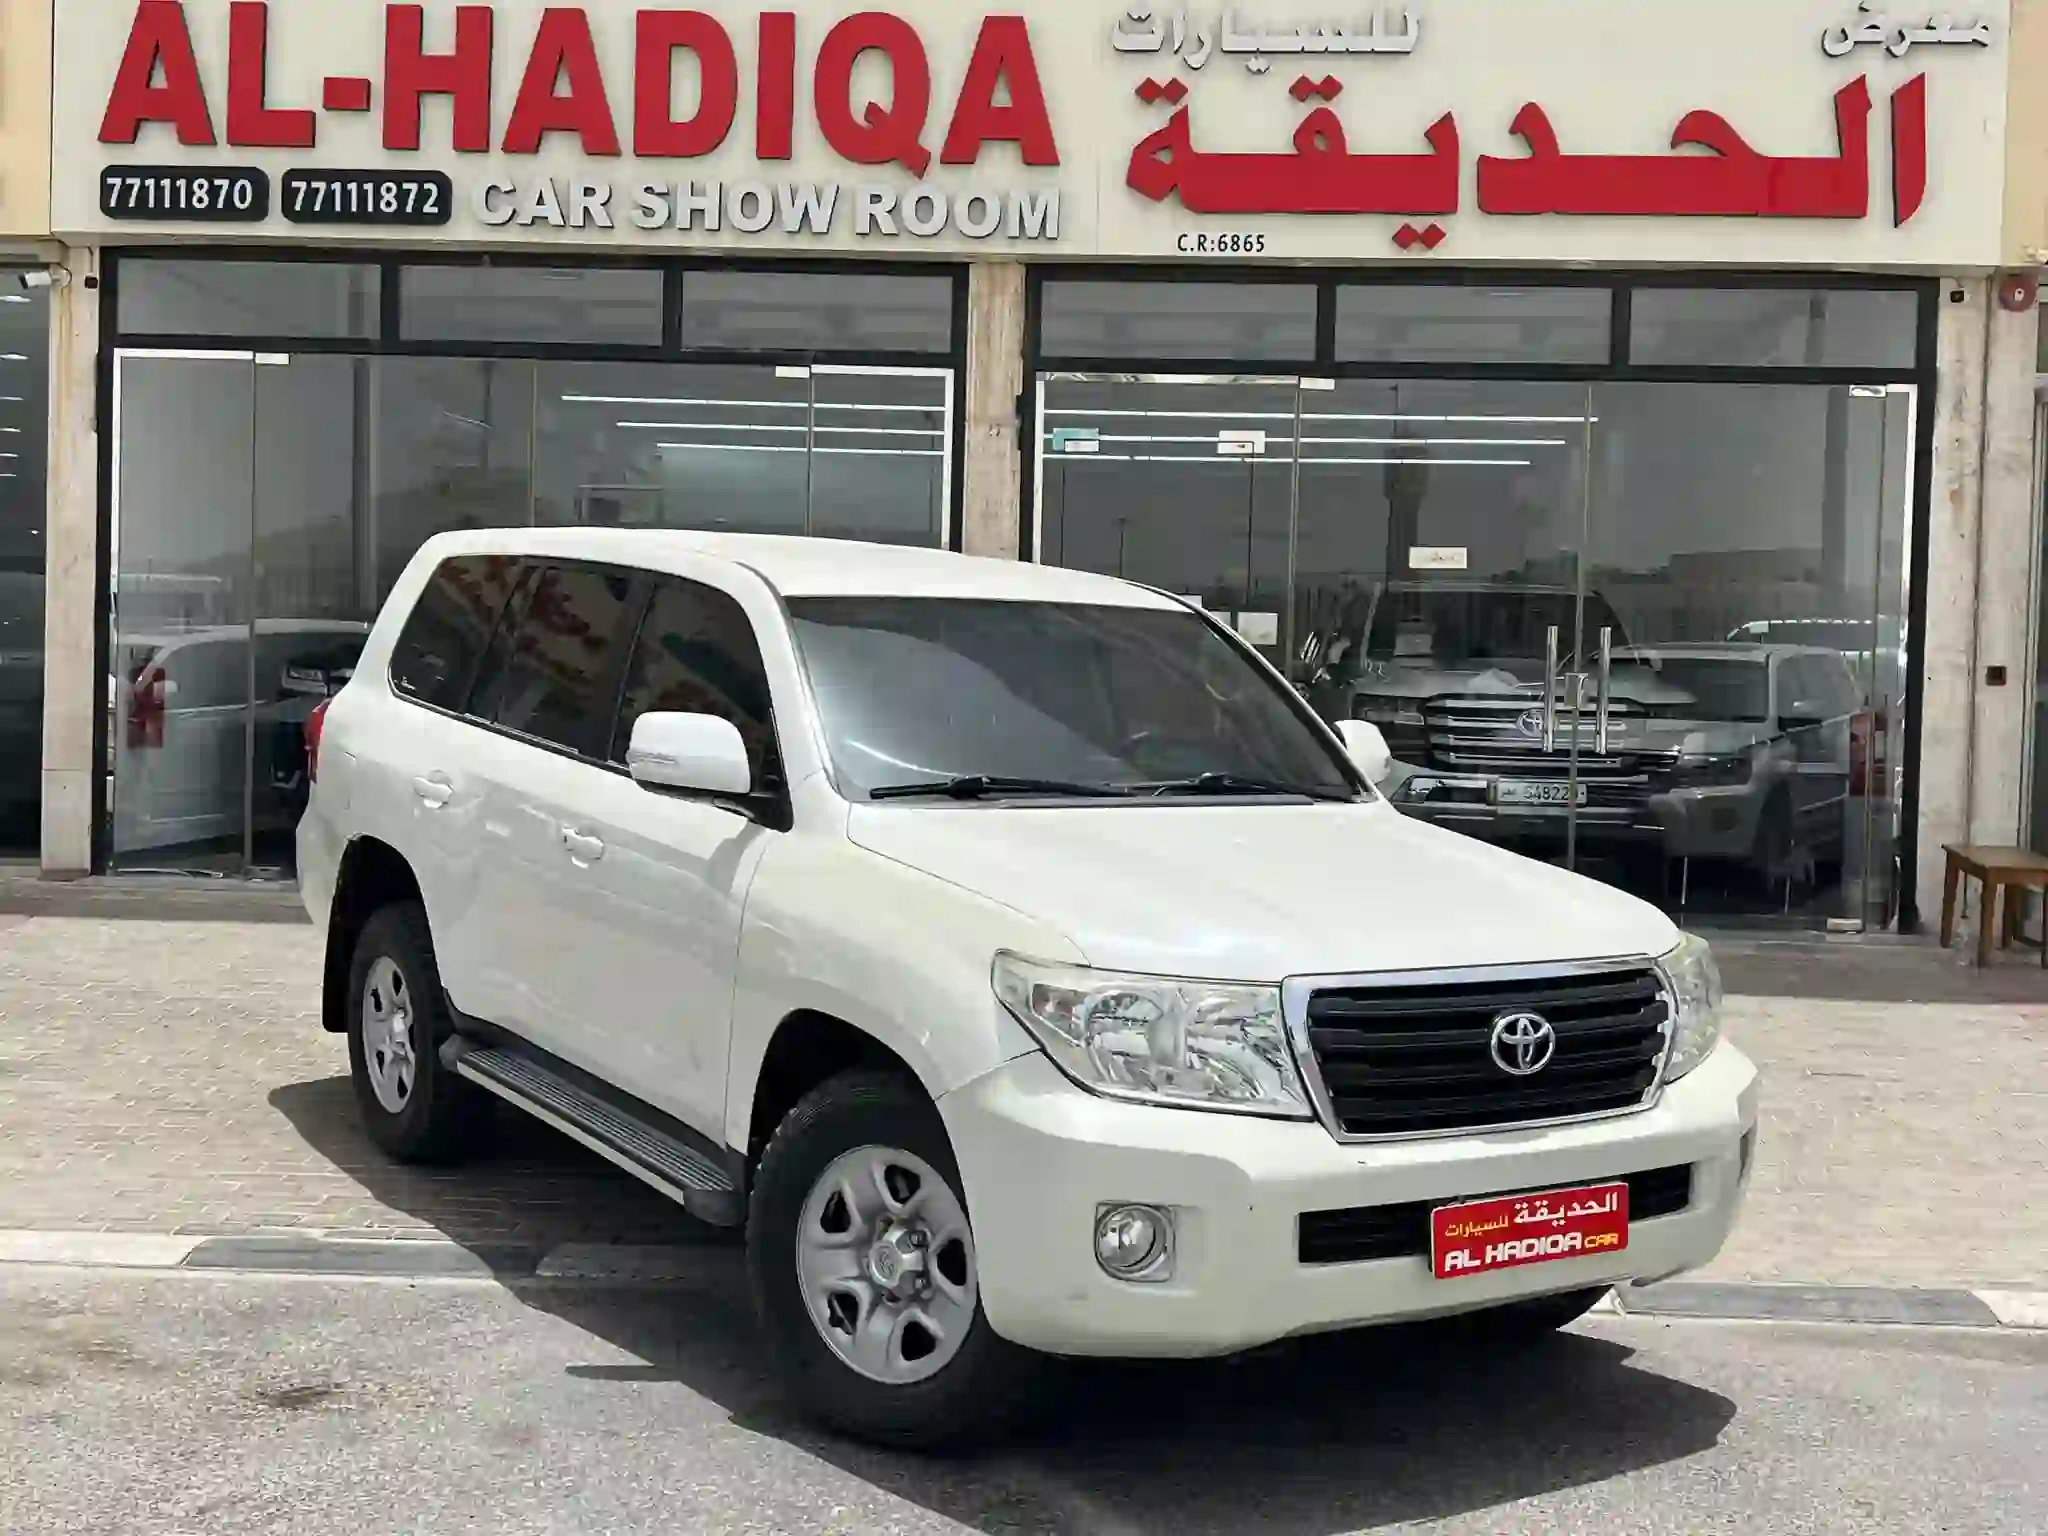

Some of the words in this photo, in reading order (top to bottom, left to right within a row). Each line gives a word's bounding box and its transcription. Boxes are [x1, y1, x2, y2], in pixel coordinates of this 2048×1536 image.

[1111, 0, 1420, 73] للسيارات
[1821, 0, 1994, 58] معرض
[97, 0, 1061, 178] AL-HADIQA
[1126, 72, 1927, 250] الحديقة
[105, 176, 254, 211] 77111870
[290, 180, 440, 214] 77111872
[478, 180, 614, 229] CAR
[633, 180, 840, 234] SHOW
[855, 184, 1060, 240] ROOM
[1177, 233, 1266, 253] C.R:6865
[1444, 1214, 1508, 1237] للسيارات
[1514, 1191, 1618, 1227] الحديقة
[1444, 1250, 1482, 1272] AL
[1584, 1232, 1619, 1249] CAR
